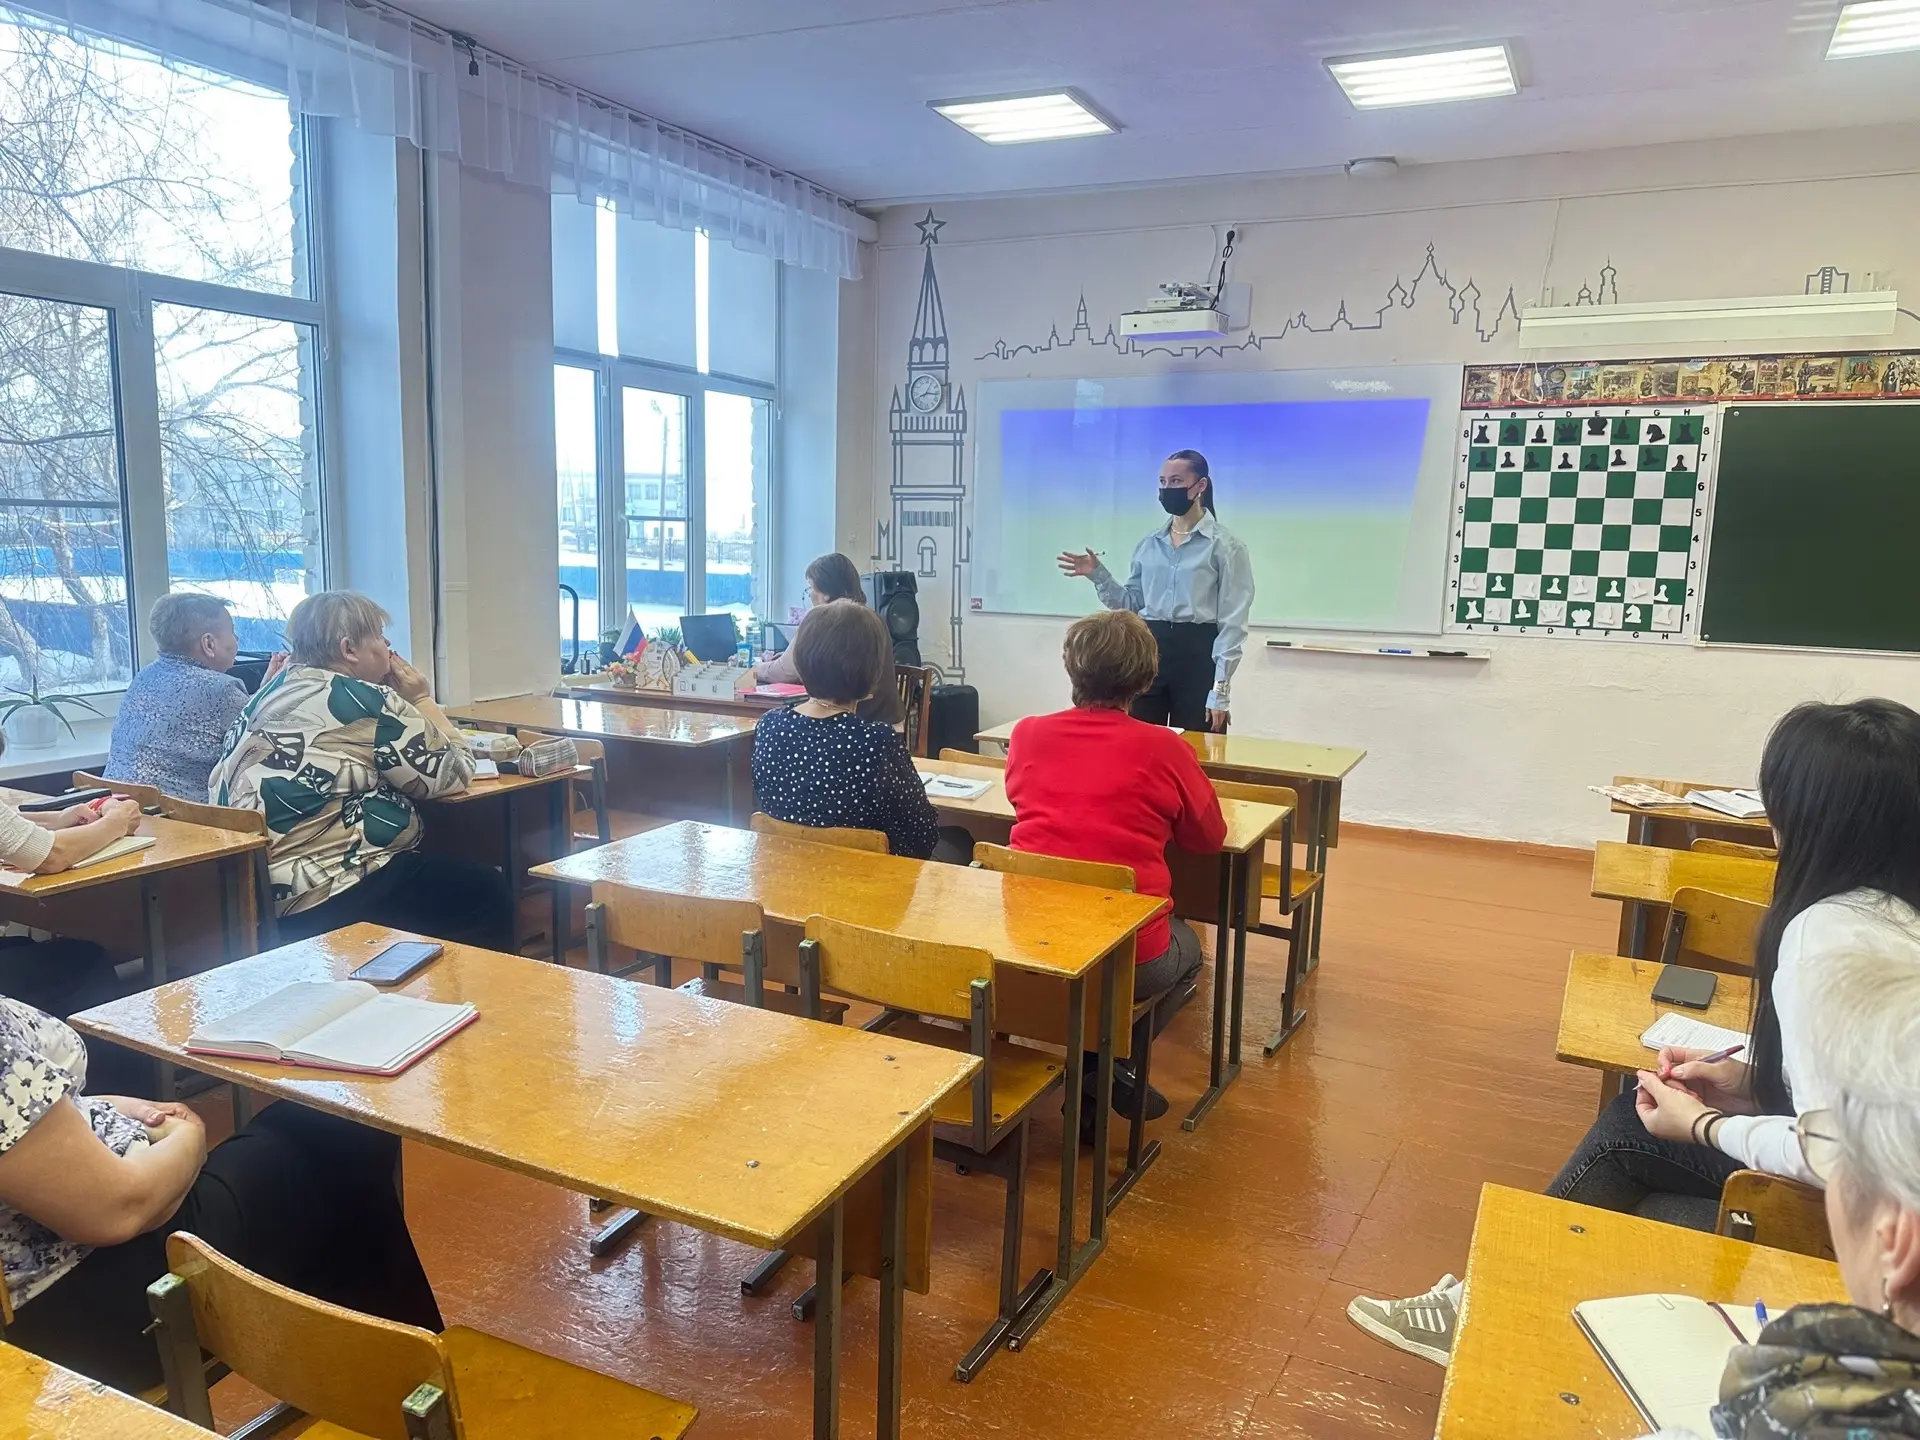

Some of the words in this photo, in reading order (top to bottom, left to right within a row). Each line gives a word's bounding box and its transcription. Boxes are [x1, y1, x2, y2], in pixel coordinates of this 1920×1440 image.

[1698, 482, 1704, 491] 6
[1454, 555, 1459, 563] 3
[1690, 561, 1696, 569] 3
